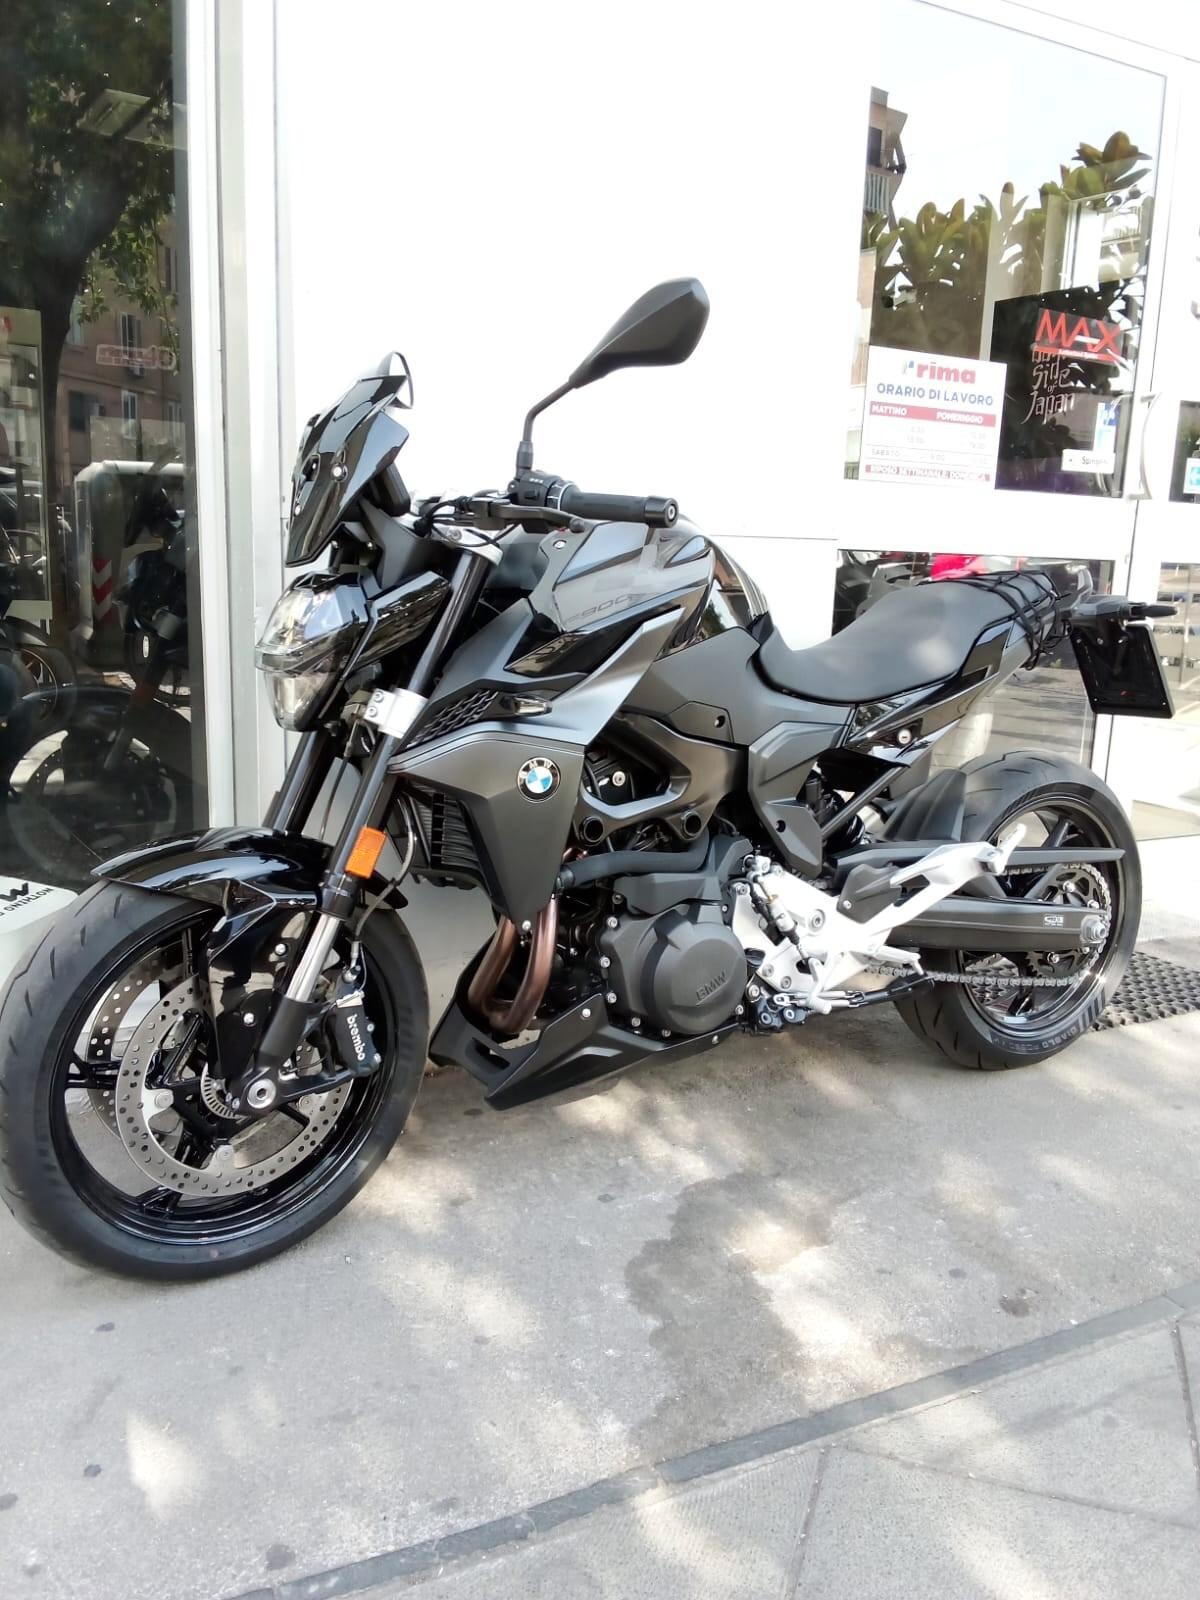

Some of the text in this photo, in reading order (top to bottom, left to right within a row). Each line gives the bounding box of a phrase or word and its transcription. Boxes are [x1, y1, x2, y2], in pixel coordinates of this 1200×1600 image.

[1035, 309, 1121, 355] MAX
[877, 383, 994, 406] ORARIO DI LAVORO
[1021, 391, 1075, 425] Japan
[871, 405, 908, 416] MATTINO
[936, 412, 984, 424] POMERIGGIO
[695, 968, 728, 1001] BMW
[347, 1013, 365, 1061] brembo
[1041, 1026, 1078, 1049] DIABLO
